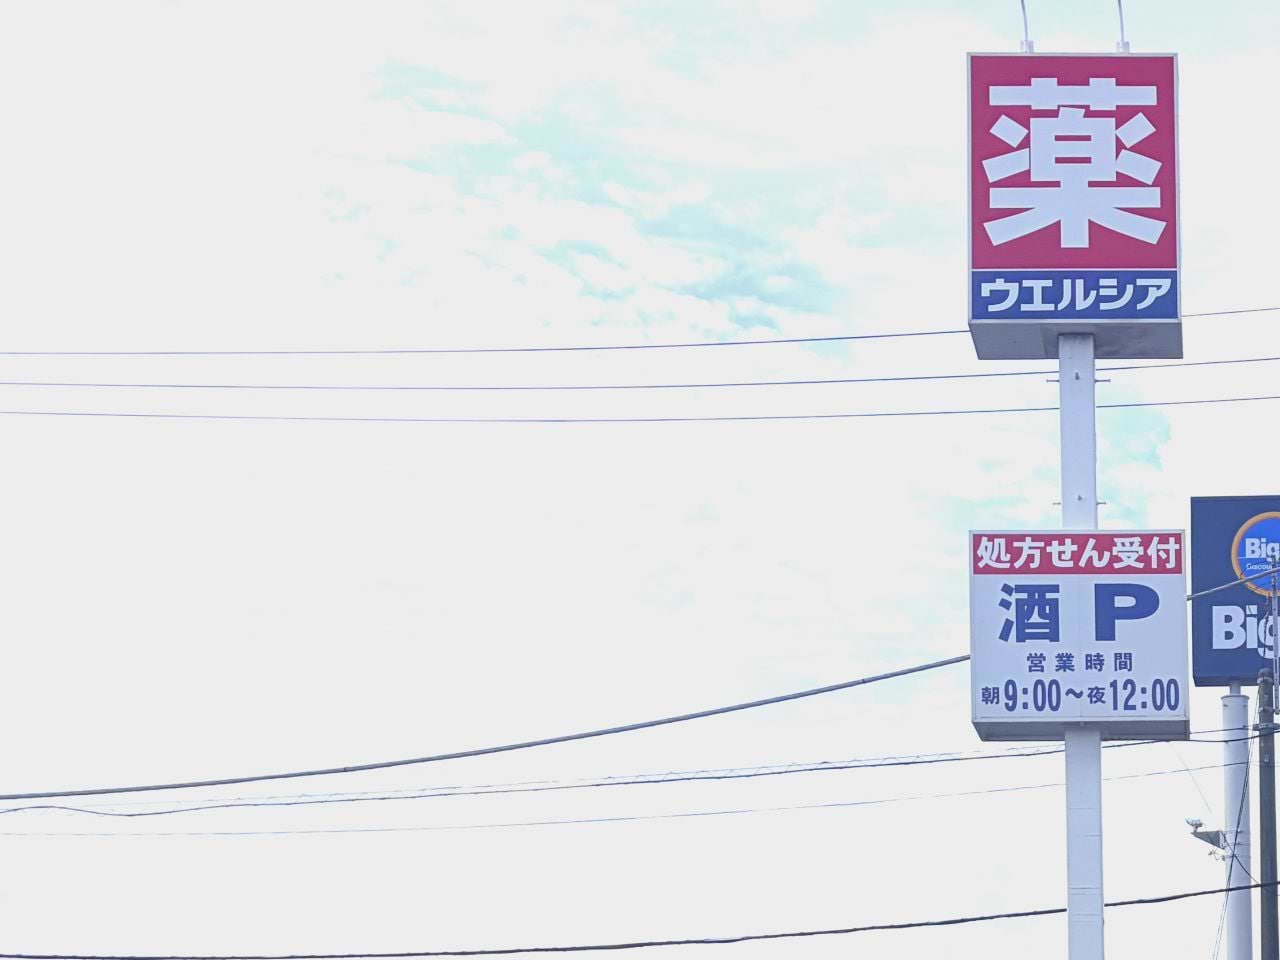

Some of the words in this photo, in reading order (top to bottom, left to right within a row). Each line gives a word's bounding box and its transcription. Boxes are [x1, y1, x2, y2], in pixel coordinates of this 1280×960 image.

[982, 77, 1167, 249] 薬
[980, 277, 1172, 313] ウエルシア
[977, 536, 1180, 569] 処方せん受付
[998, 583, 1060, 643] 酒
[1094, 583, 1160, 641] P
[1026, 652, 1133, 673] 営業時間
